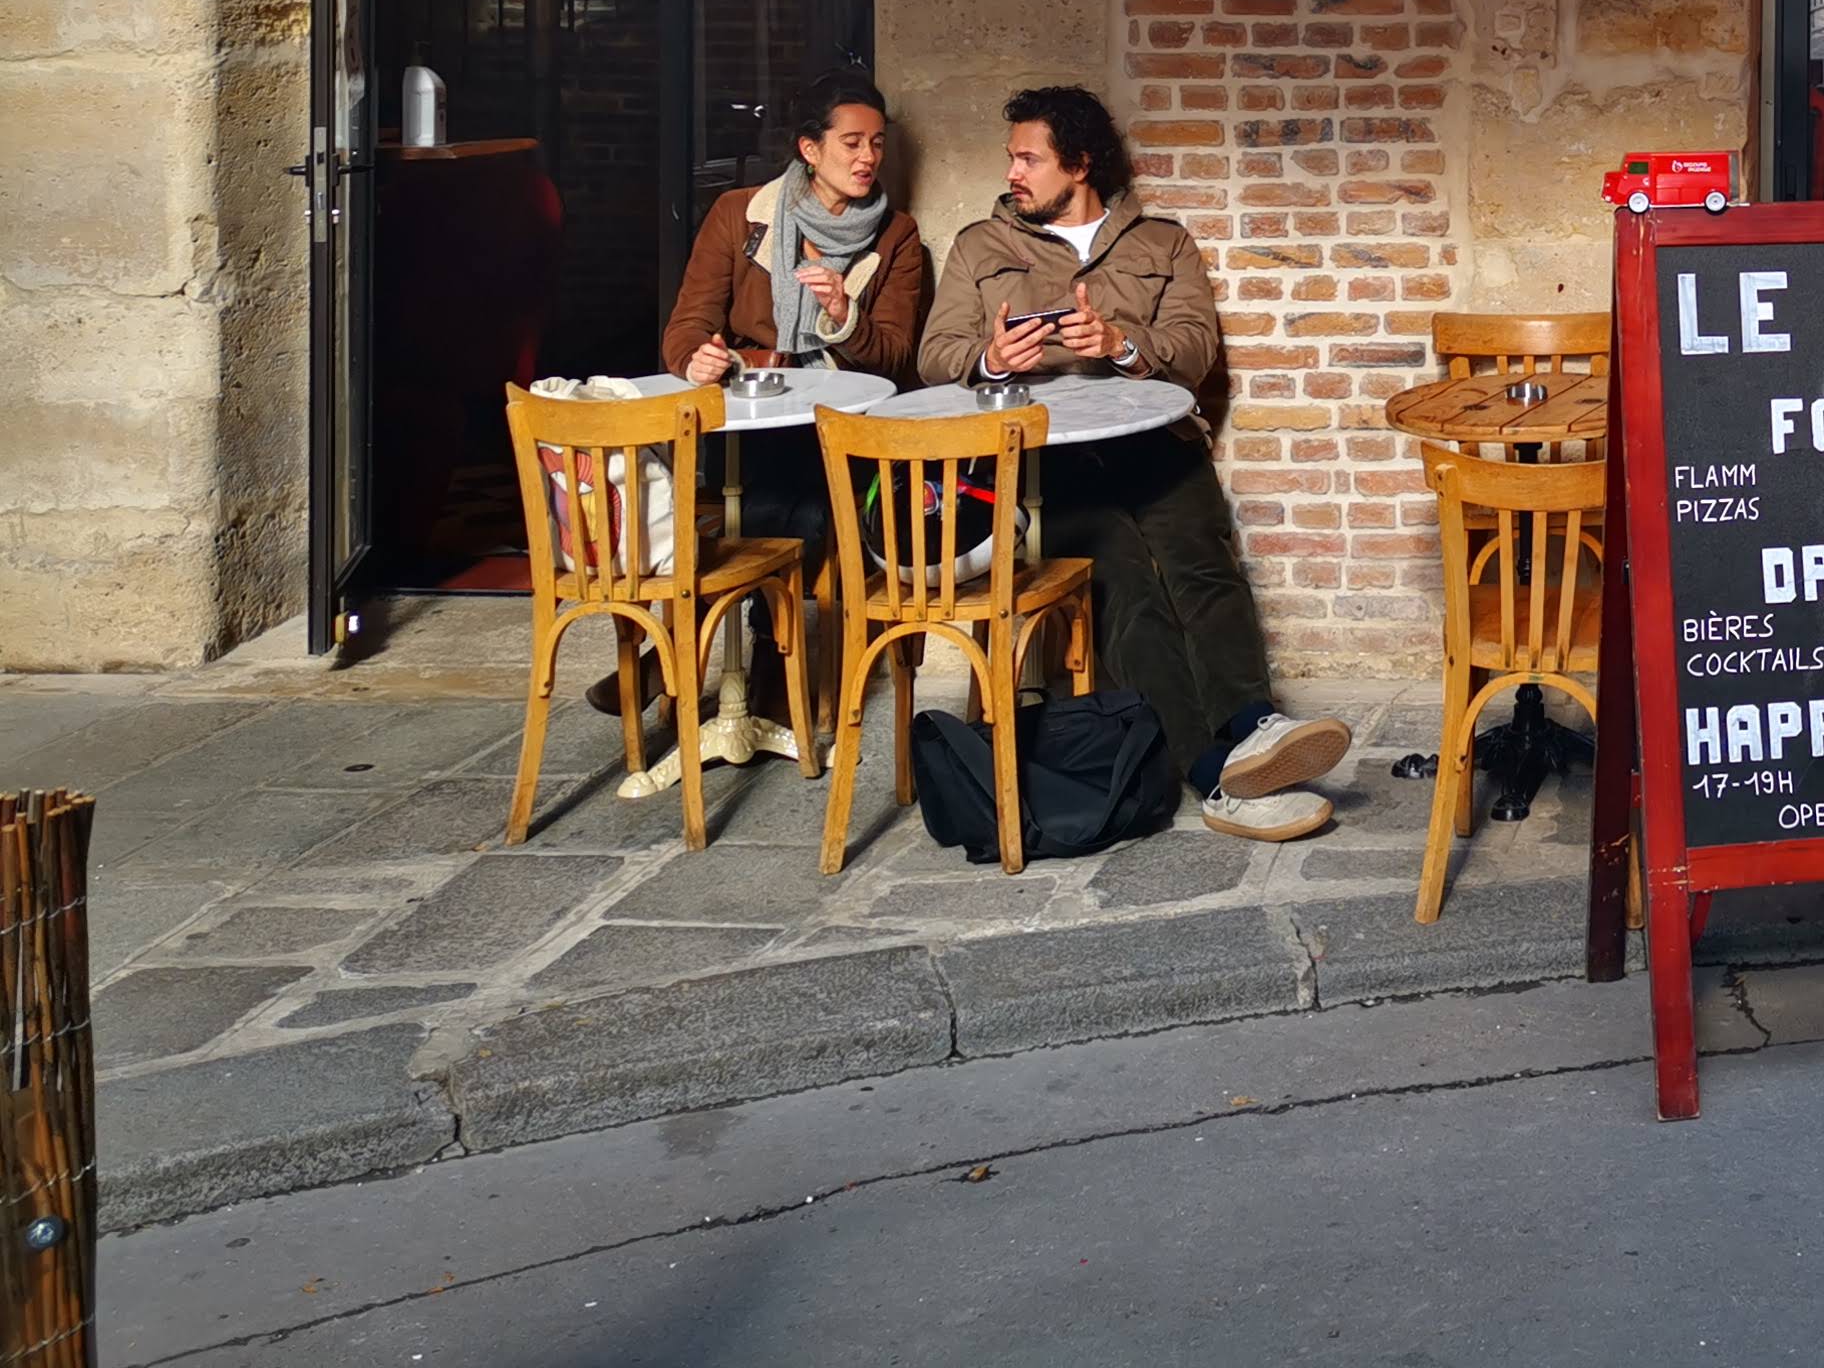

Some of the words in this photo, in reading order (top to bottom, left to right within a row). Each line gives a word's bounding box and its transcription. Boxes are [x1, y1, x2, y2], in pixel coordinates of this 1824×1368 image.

[1677, 271, 1791, 356] LE
[1674, 463, 1756, 489] FLAMM
[1676, 496, 1760, 522] PIZZAS
[1683, 611, 1774, 642] BIÈRES
[1686, 646, 1824, 677] COCKTAILS
[1692, 770, 1793, 798] 17-19H
